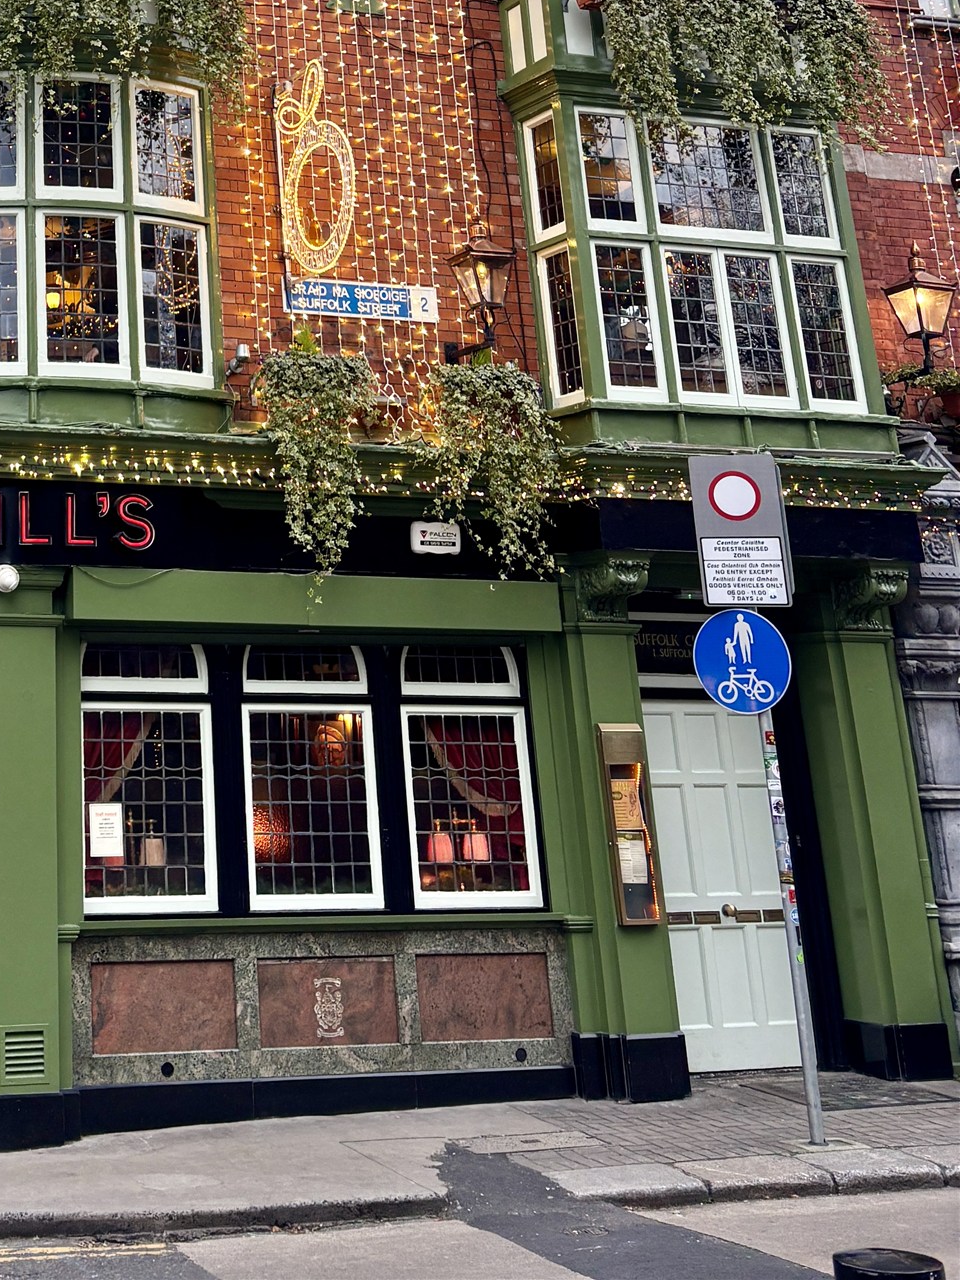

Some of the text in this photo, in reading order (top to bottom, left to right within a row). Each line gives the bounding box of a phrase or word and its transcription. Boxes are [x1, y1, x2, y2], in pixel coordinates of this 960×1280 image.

[332, 287, 350, 298] NA
[298, 298, 401, 316] SUFFOLK STREET
[420, 297, 429, 312] 2
[634, 633, 679, 647] SUFFOLK
